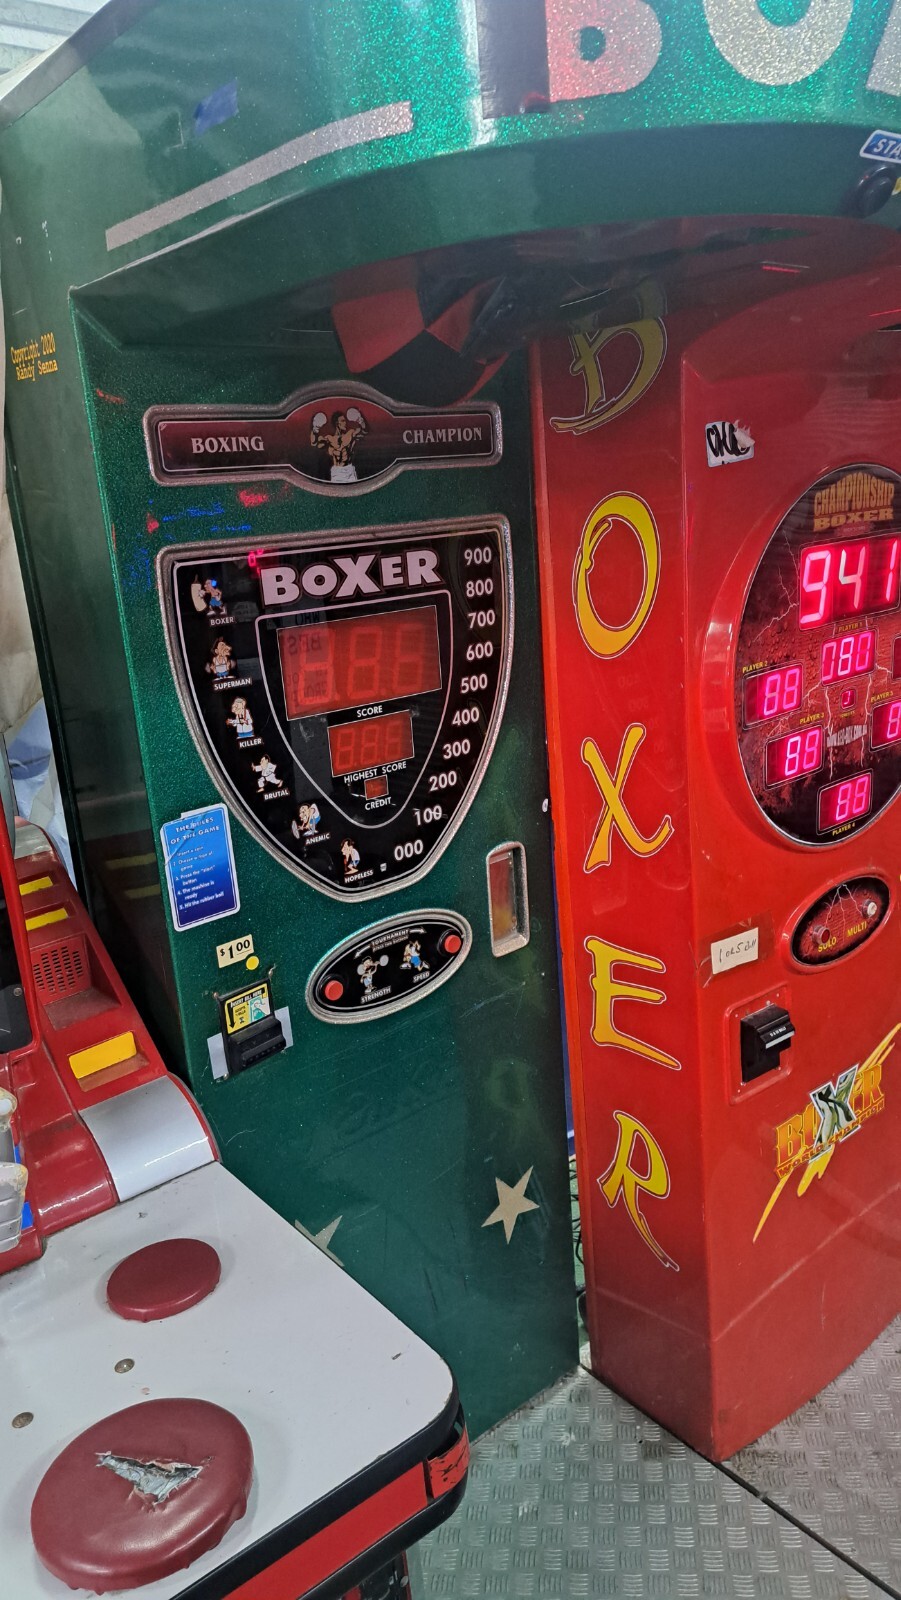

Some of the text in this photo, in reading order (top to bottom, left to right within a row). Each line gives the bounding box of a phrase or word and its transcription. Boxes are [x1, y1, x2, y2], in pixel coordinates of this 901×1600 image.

[16, 360, 58, 381] Randy Senna
[191, 427, 483, 454] BOXING CHAMPION
[814, 472, 895, 516] CHAMPIONSHIP
[813, 507, 894, 532] BOXER
[464, 546, 492, 566] 900
[260, 549, 442, 606] BOXER
[800, 540, 898, 624] 941
[466, 578, 494, 598] 800
[210, 616, 234, 626] BOXER
[467, 609, 496, 629] 700
[838, 623, 859, 632] PLAYER
[466, 641, 494, 661] 600
[742, 662, 763, 673] PLAYER
[214, 677, 251, 691] SUPERMAN
[460, 673, 488, 693] 500
[763, 667, 800, 716] 88
[870, 692, 890, 703] PLAYER
[356, 705, 383, 718] SCORE
[452, 707, 480, 726] 400
[799, 714, 819, 725] PLAYER
[239, 737, 262, 748] KILLER
[442, 739, 471, 760] 300
[343, 761, 407, 784] HIGHEST SCORE
[428, 770, 457, 792] 200
[264, 789, 289, 801] BRUTAL
[364, 797, 392, 811] CREDIT
[413, 805, 443, 826] 100
[175, 823, 190, 833] THE
[198, 825, 220, 836] GAME
[832, 824, 851, 836] PLAYER
[305, 833, 330, 845] ANEMIC
[393, 839, 424, 861] 000
[344, 870, 374, 884] HOPELESS
[184, 901, 192, 909] Hit
[192, 899, 200, 907] the
[199, 894, 215, 904] rubber
[215, 890, 225, 899] ball
[371, 929, 409, 947] TOURNAMENT
[847, 920, 867, 938] MULTI
[818, 936, 837, 953] SOLO
[413, 971, 430, 983] SPEED
[360, 986, 391, 1004] STRENGTH
